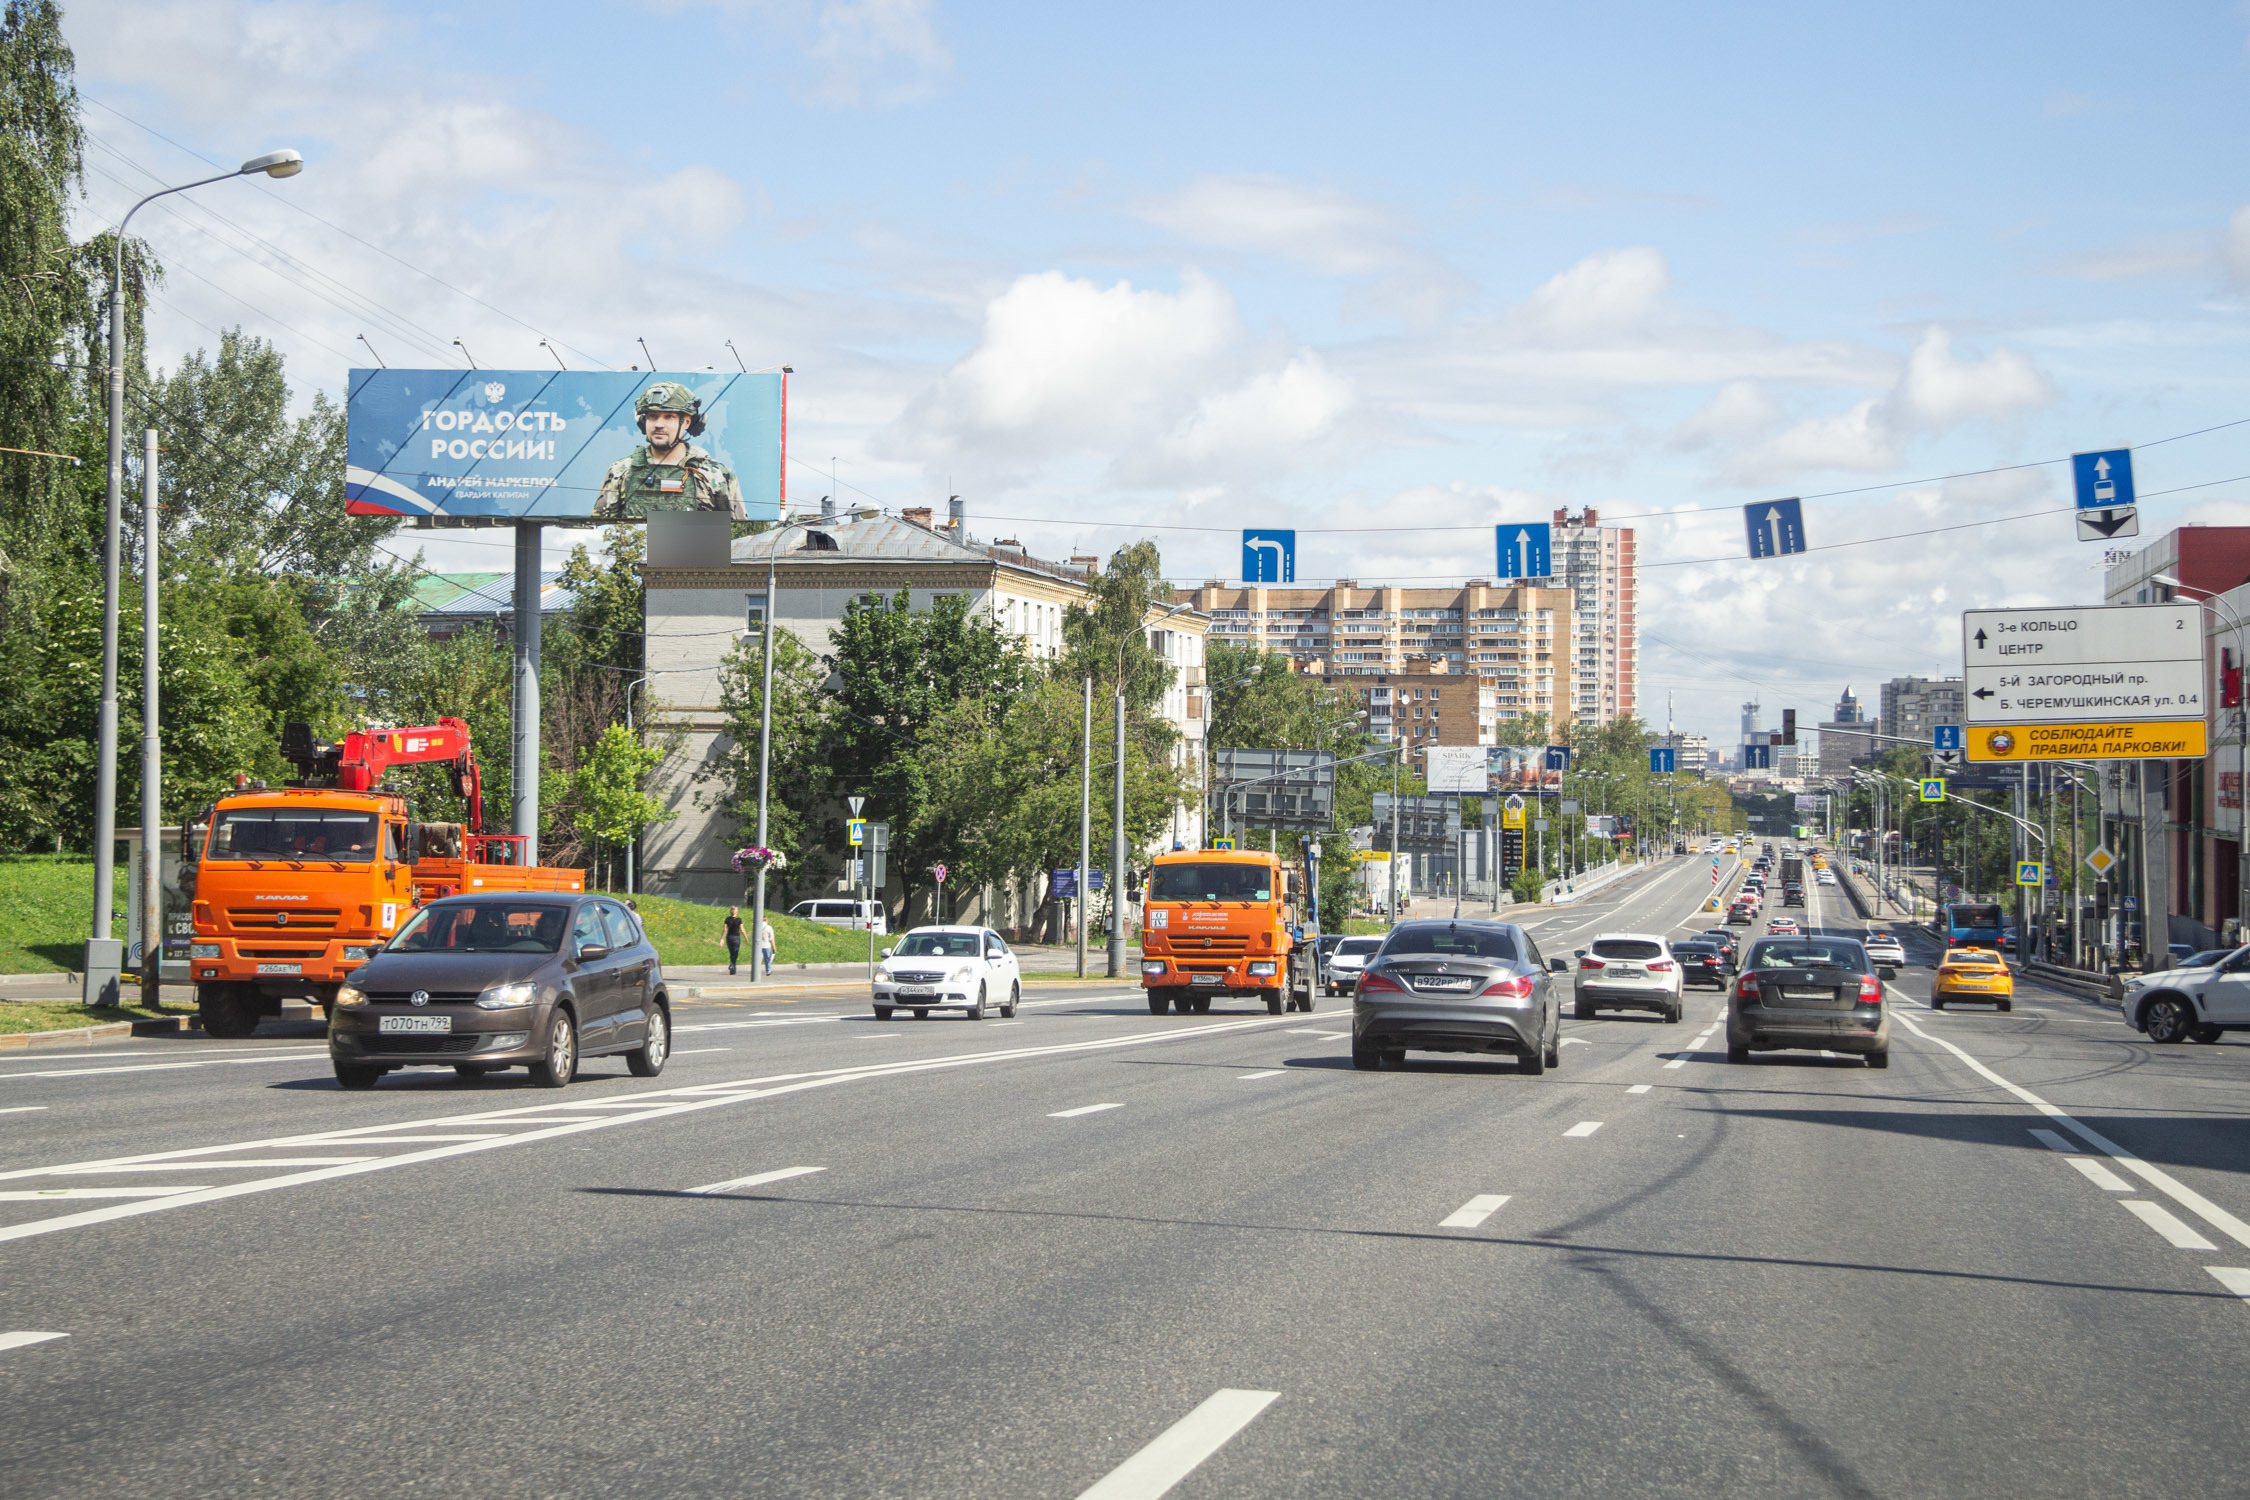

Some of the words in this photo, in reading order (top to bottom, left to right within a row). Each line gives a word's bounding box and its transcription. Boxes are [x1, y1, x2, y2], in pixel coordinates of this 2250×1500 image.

[422, 410, 567, 433] ГОРДОСТЬ
[431, 439, 555, 460] РОССИИ!
[427, 474, 482, 488] АНДРЕЙ
[493, 491, 530, 499] КАПИТАН
[1997, 622, 2017, 633] 3-е
[2020, 620, 2078, 632] КОЛЬЦО
[2175, 619, 2184, 630] 2
[1998, 643, 2043, 656] ЦЕНТР
[1999, 674, 2020, 687] 5-Й
[2027, 672, 2124, 686] ЗАГОРОДНЫЙ
[2128, 675, 2148, 685] пр.
[2000, 699, 2013, 709] Б.
[2017, 695, 2150, 709] ЧЕРЕМУШКИНСКАЯ
[2154, 697, 2174, 707] ул.
[2178, 694, 2198, 705] 0.4
[2029, 726, 2133, 742] СОБЛЮДАЙТЕ
[2029, 743, 2098, 755] ПРАВИЛА
[2102, 741, 2186, 753] ПАРКОВКИ!
[1417, 976, 1453, 987] В922РР
[384, 1017, 428, 1030] Т070ТН
[430, 1017, 448, 1027] 799
